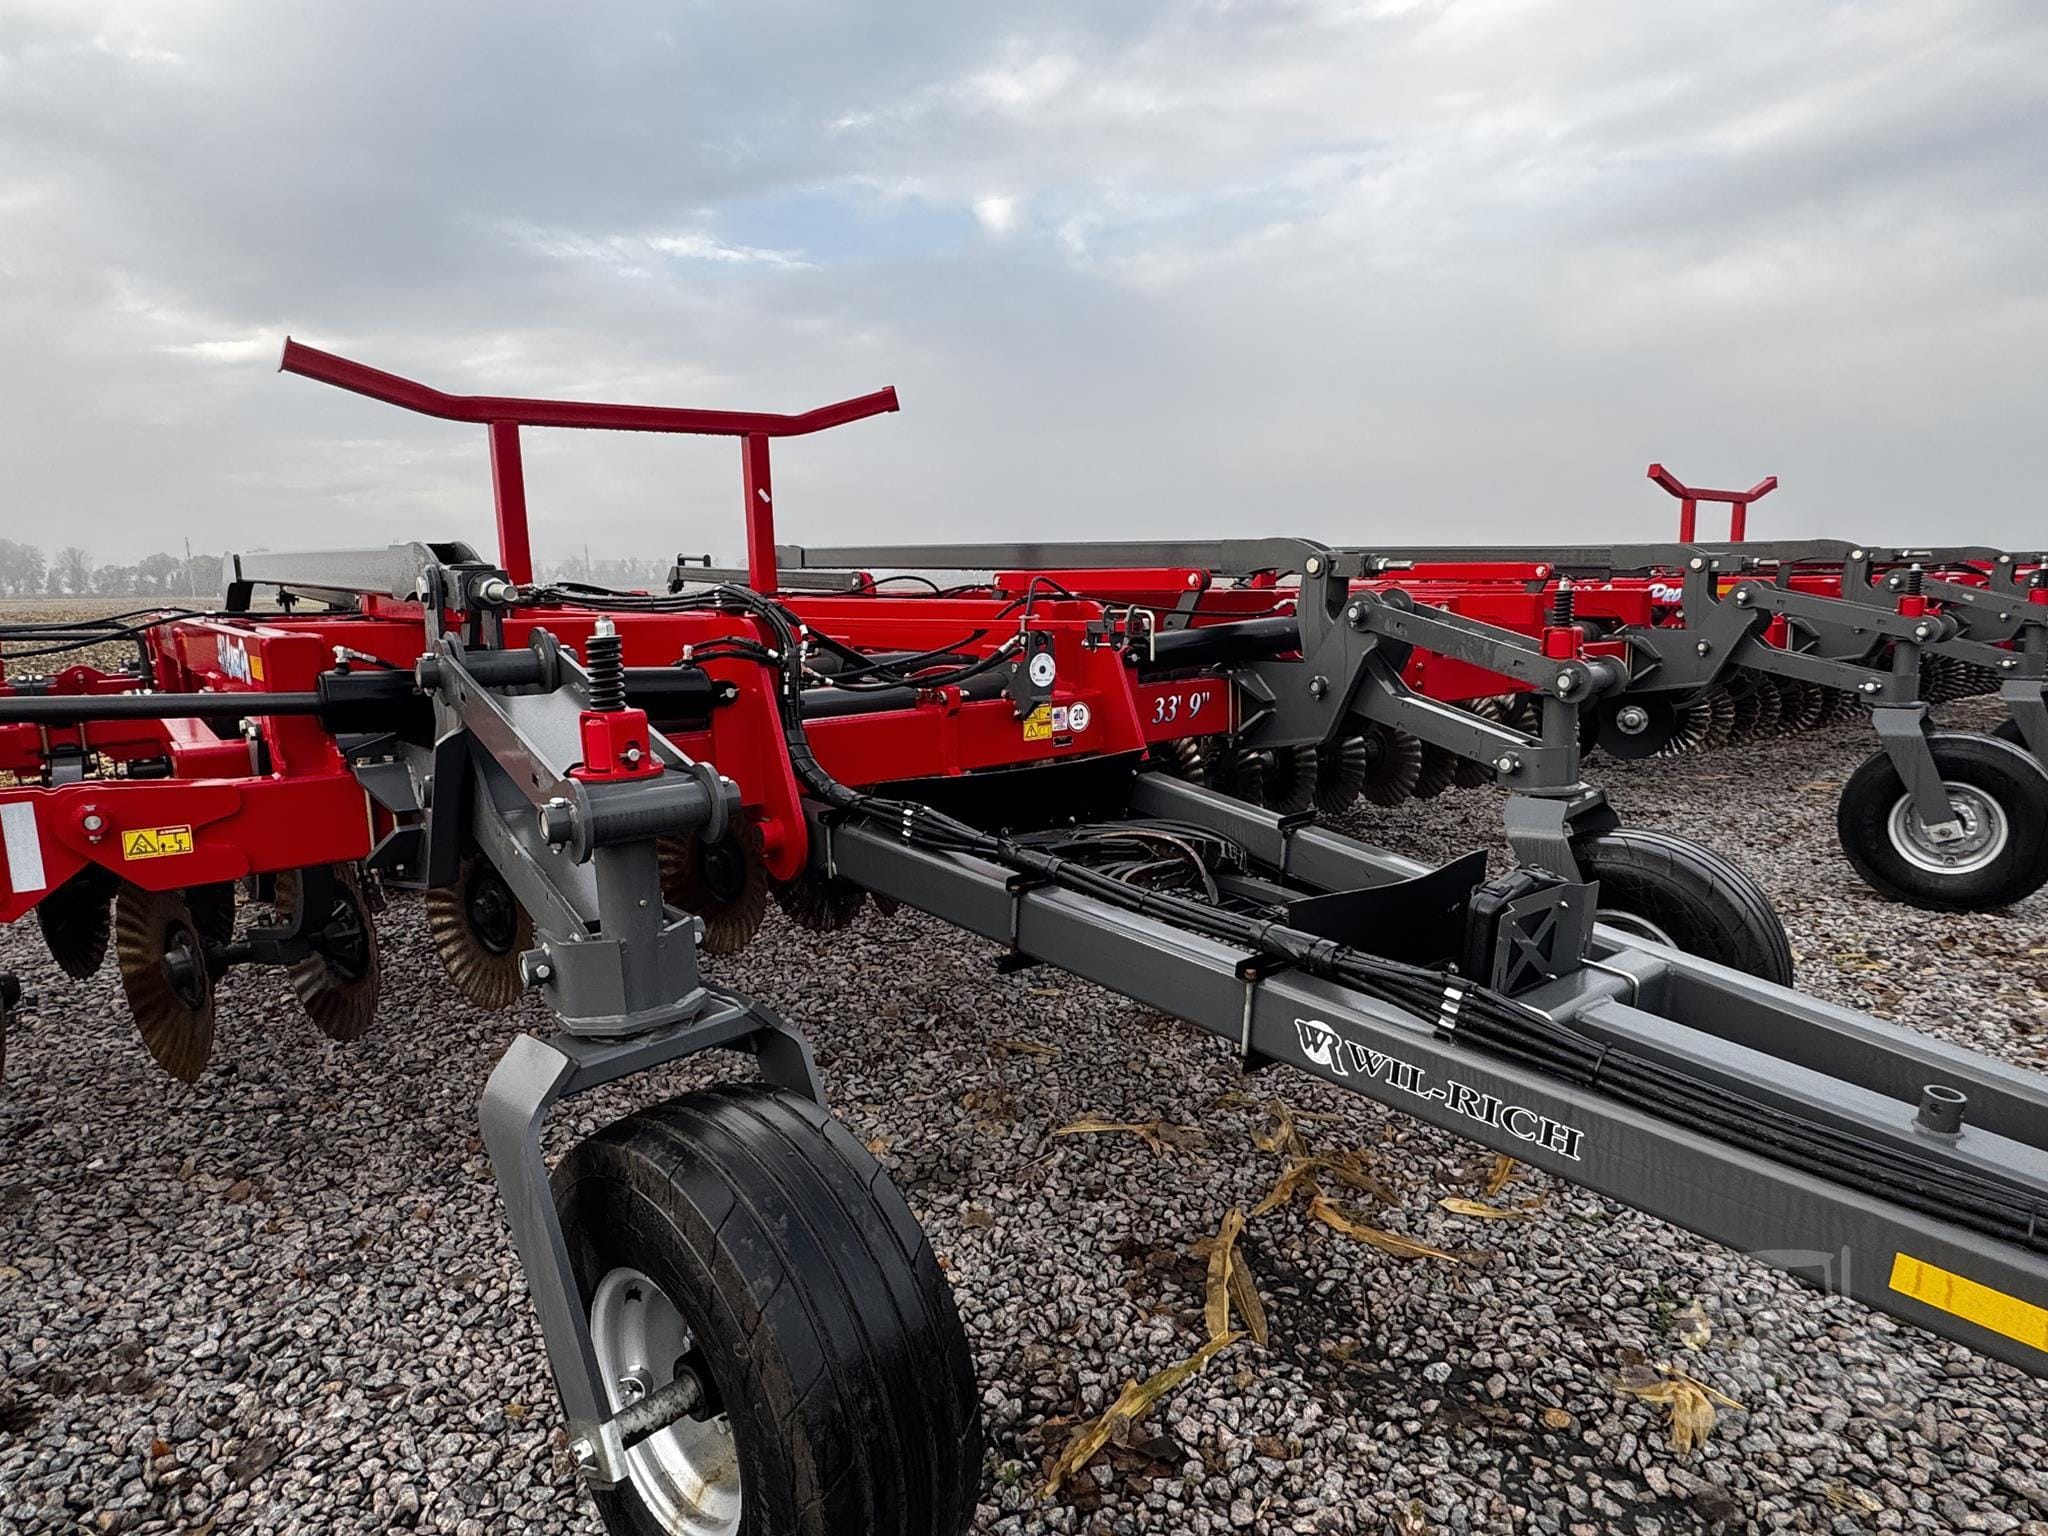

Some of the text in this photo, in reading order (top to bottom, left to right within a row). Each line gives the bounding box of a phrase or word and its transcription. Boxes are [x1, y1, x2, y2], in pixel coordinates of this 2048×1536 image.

[1073, 708, 1084, 721] 20
[1151, 691, 1210, 724] 33' 9"
[1345, 1039, 1585, 1162] WIL-RICH
